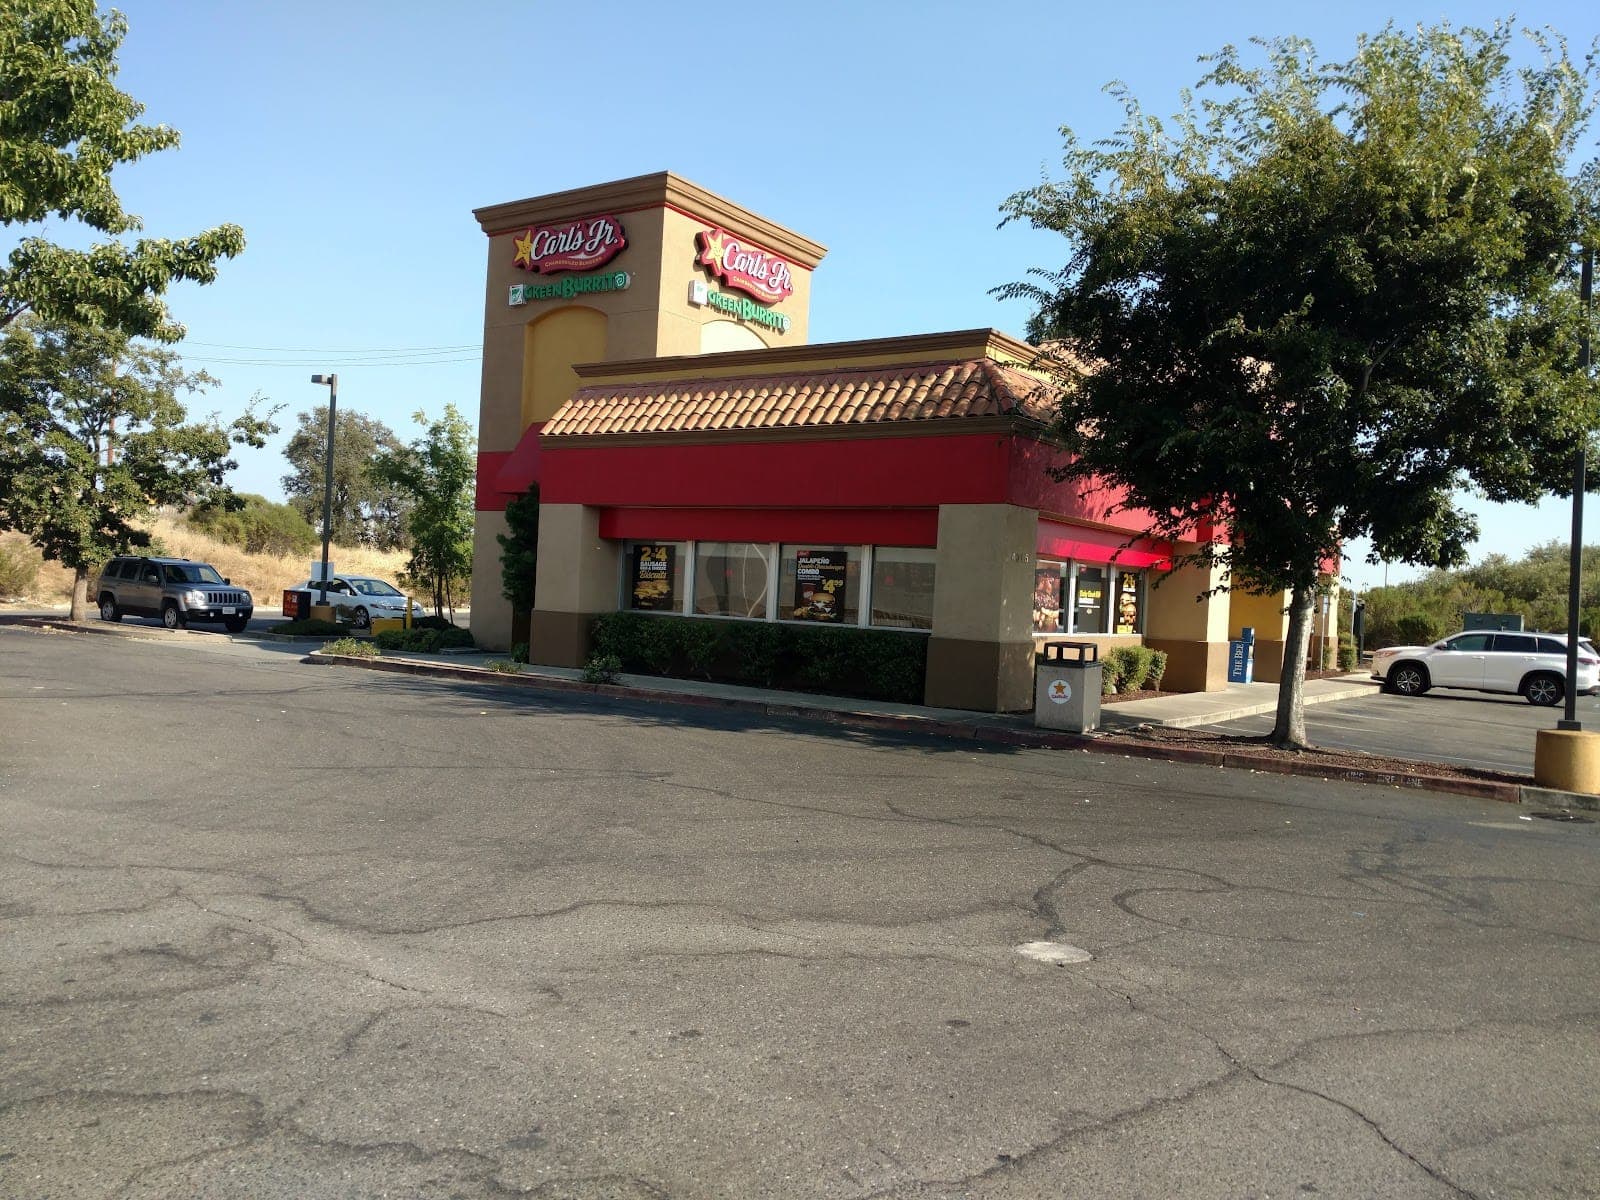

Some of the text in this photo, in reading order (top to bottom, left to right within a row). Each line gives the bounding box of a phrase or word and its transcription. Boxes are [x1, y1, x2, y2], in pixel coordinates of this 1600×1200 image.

[530, 219, 618, 260] Carl's Jr.
[722, 242, 769, 279] Carl's
[768, 260, 793, 292] Jr.
[707, 289, 742, 315] GREEN
